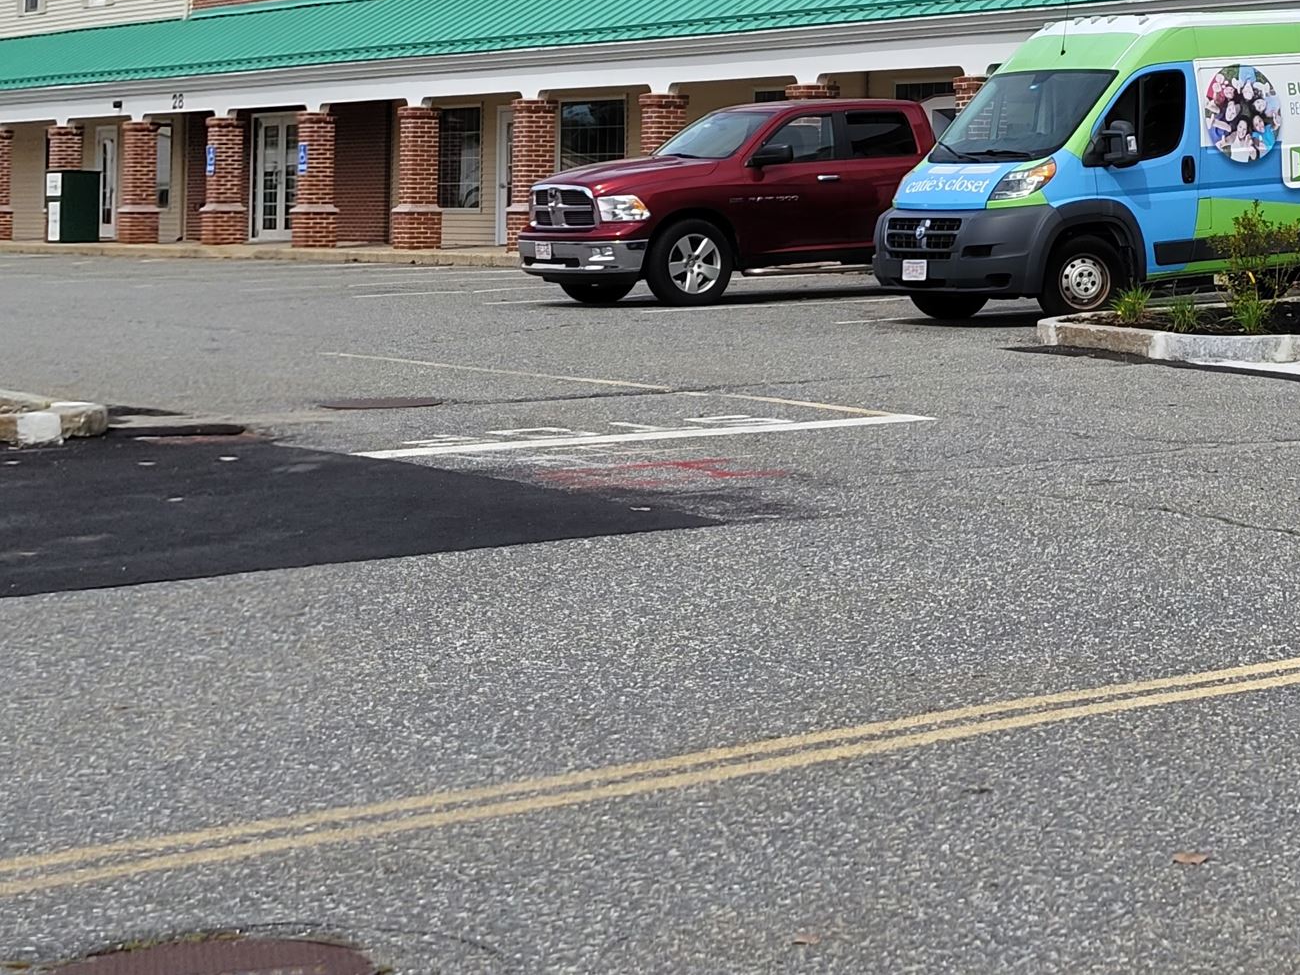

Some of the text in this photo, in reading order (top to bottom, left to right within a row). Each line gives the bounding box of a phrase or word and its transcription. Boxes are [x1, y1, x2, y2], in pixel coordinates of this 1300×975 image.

[172, 93, 184, 110] 28
[906, 175, 989, 194] catie's closet
